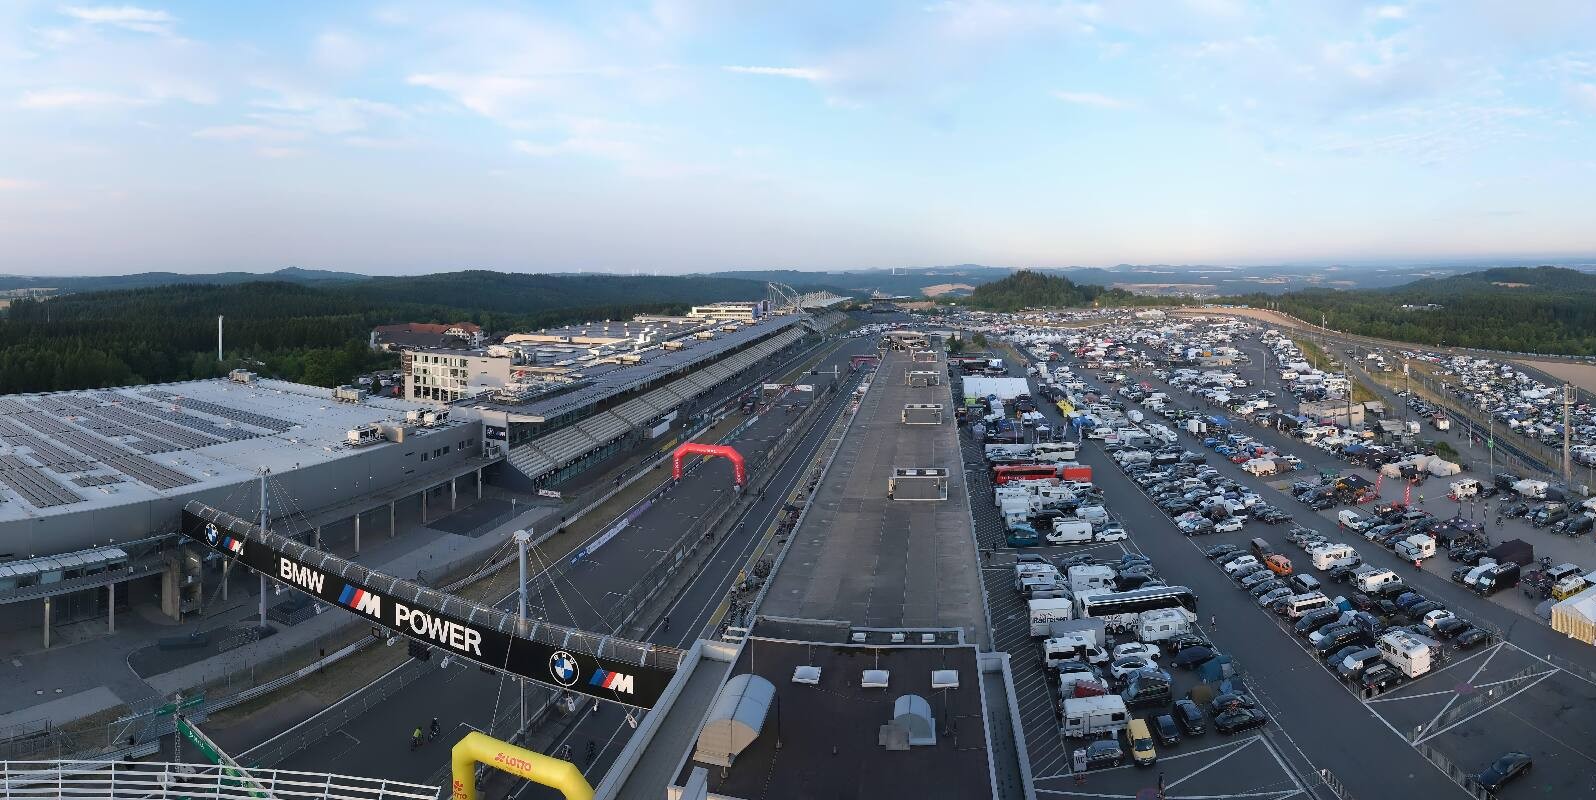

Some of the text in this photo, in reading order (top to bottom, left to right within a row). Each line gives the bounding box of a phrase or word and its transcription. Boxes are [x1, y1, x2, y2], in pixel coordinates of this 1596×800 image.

[280, 557, 482, 656] BMW M POWER
[605, 671, 634, 694] M
[505, 756, 532, 772] LOTTO
